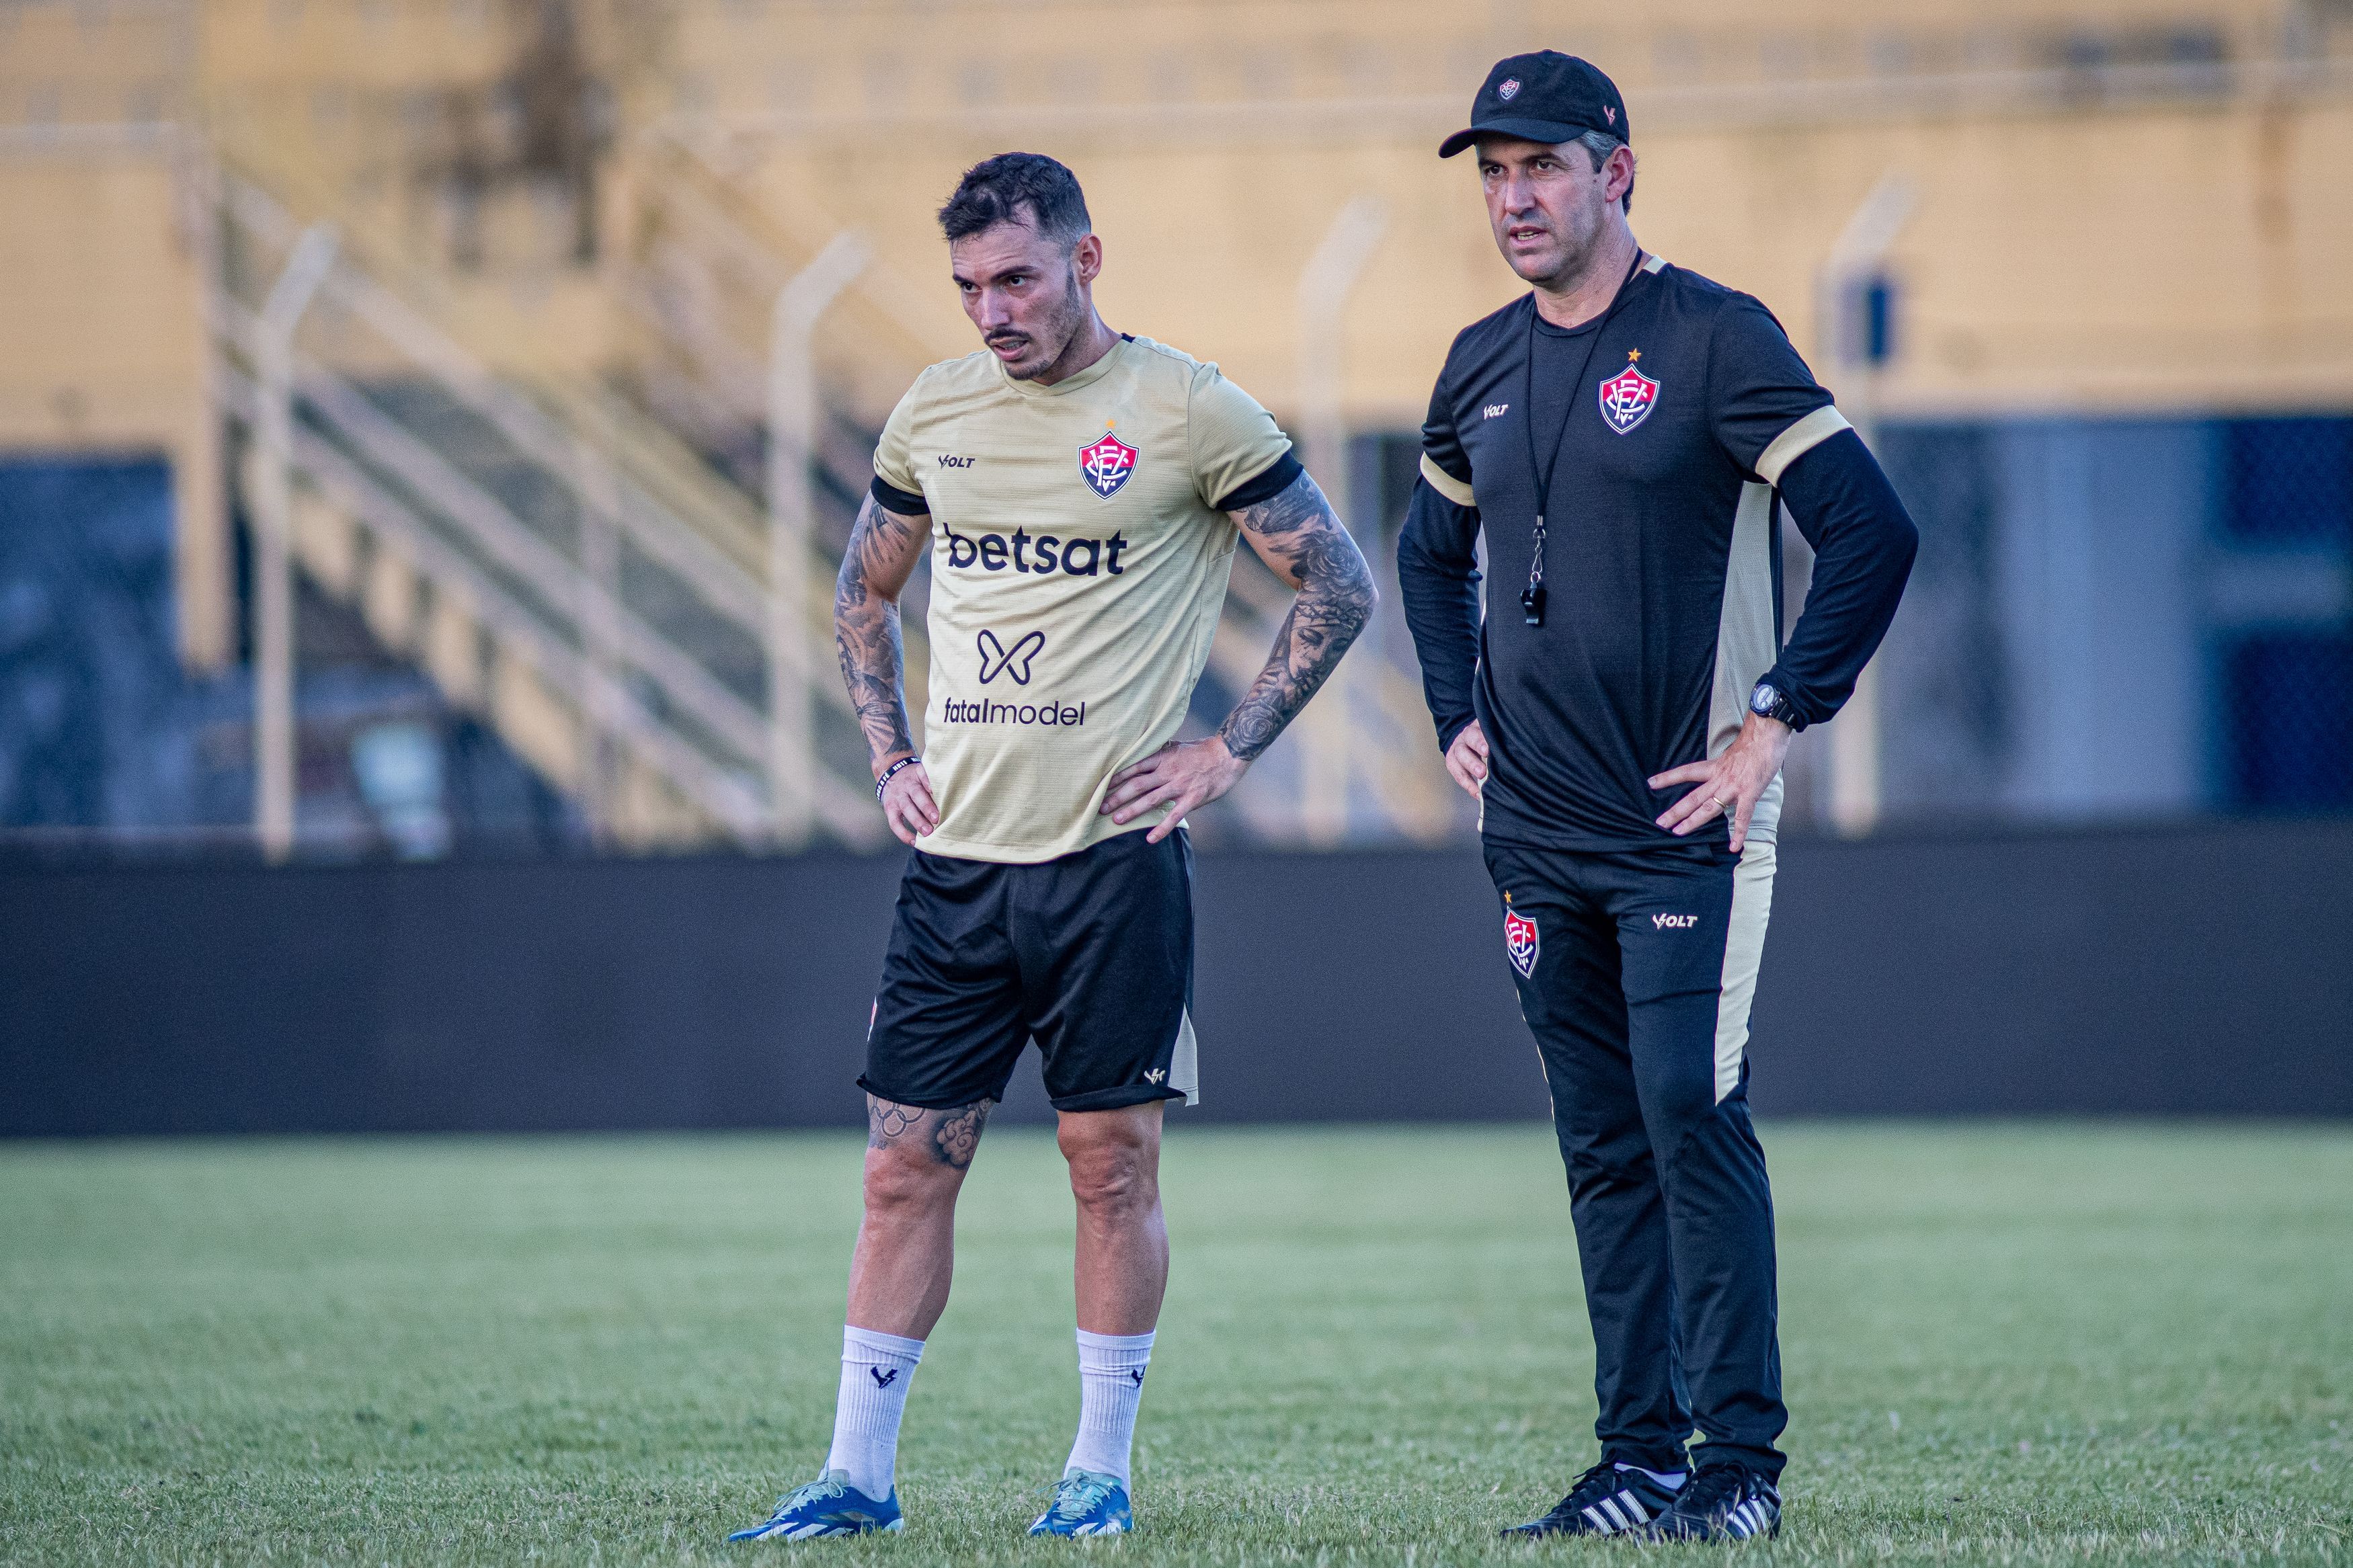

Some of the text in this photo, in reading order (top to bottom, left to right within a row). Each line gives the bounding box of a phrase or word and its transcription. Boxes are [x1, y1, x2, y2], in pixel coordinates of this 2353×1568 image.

[1484, 404, 1509, 420] VOLT
[938, 454, 975, 469] VOLT
[943, 522, 1127, 577] betsat
[943, 696, 1085, 726] fatalmodel
[1652, 913, 1698, 930] VOLT
